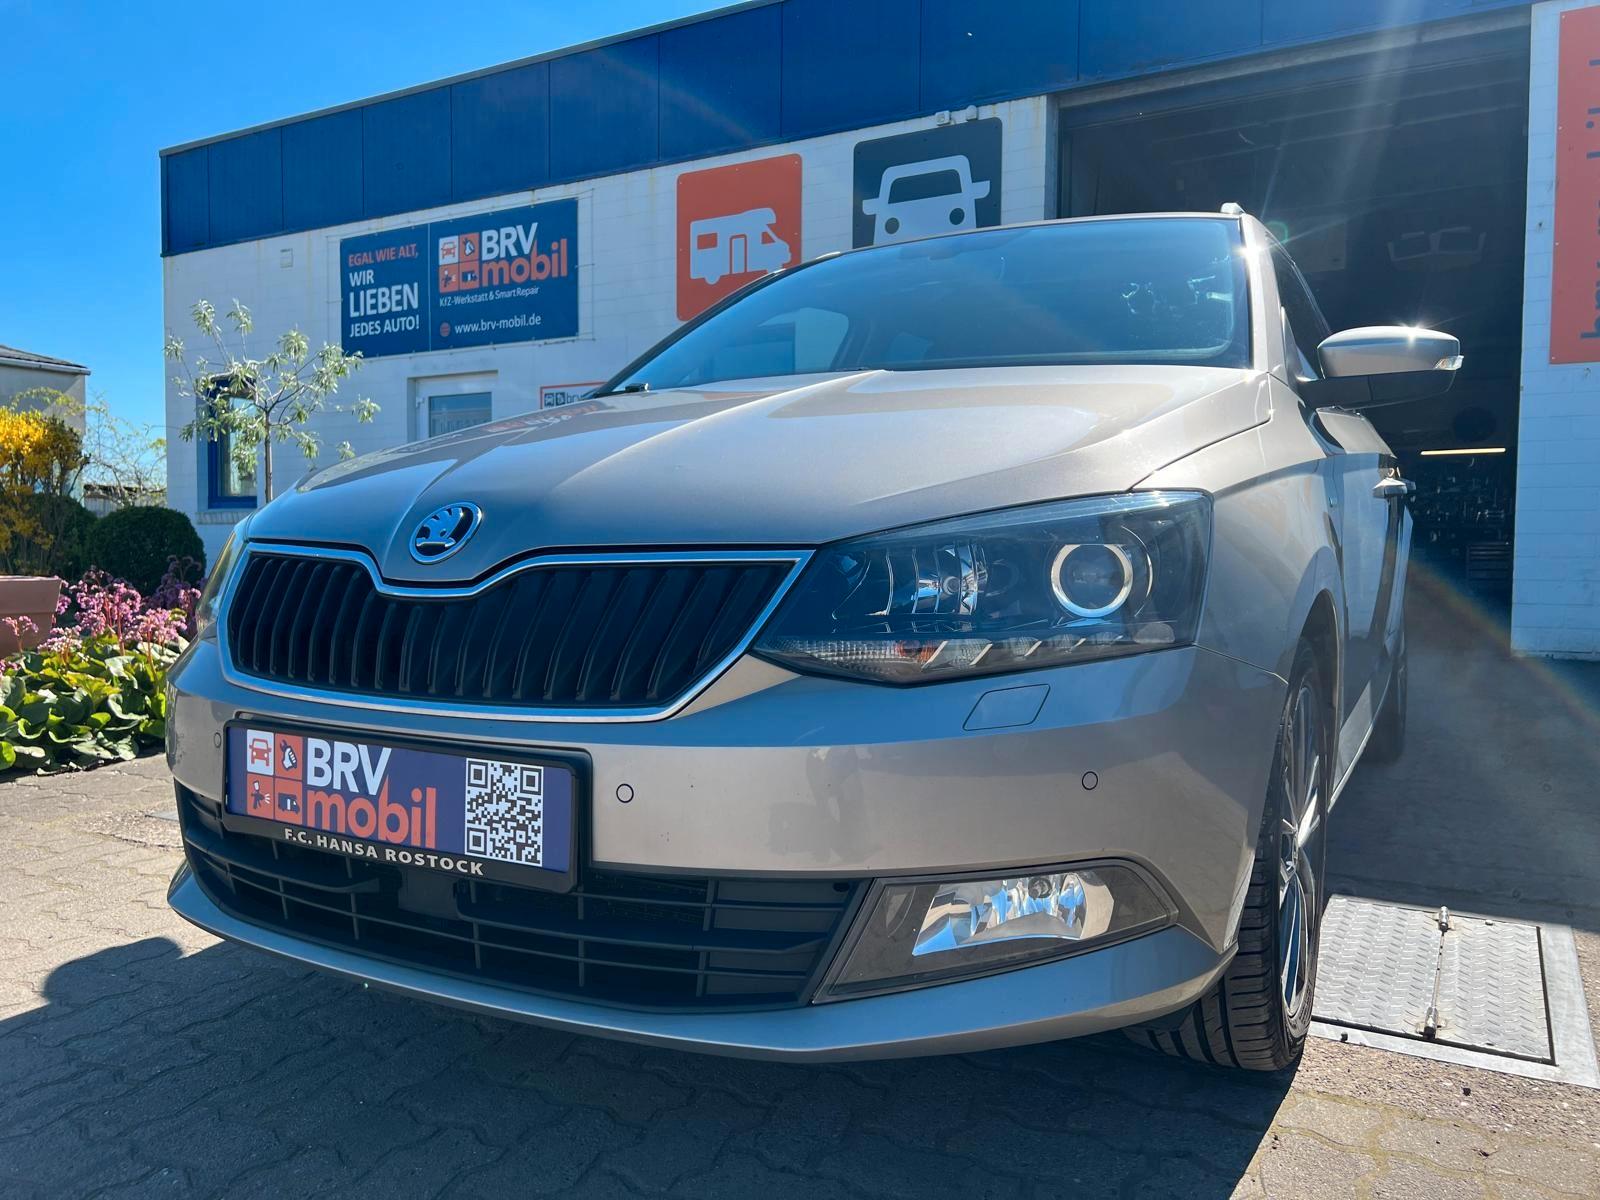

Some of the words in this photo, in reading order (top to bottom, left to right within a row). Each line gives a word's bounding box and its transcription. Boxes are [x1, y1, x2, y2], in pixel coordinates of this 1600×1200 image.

[348, 251, 374, 267] EGAL
[375, 247, 396, 262] WIE
[398, 243, 419, 259] ALT,
[481, 222, 538, 261] BRV
[349, 269, 375, 287] WIR
[481, 238, 568, 287] mobil
[349, 282, 419, 318] LIEBEN
[349, 320, 381, 338] JEDES
[383, 314, 420, 334] AUTO!
[454, 313, 541, 334] www.brv-mobil.de
[307, 737, 392, 796] BRV
[307, 775, 436, 849] mobil
[284, 828, 313, 845] F.C.
[316, 835, 378, 859] HANSA
[385, 848, 484, 876] ROSTOCK
